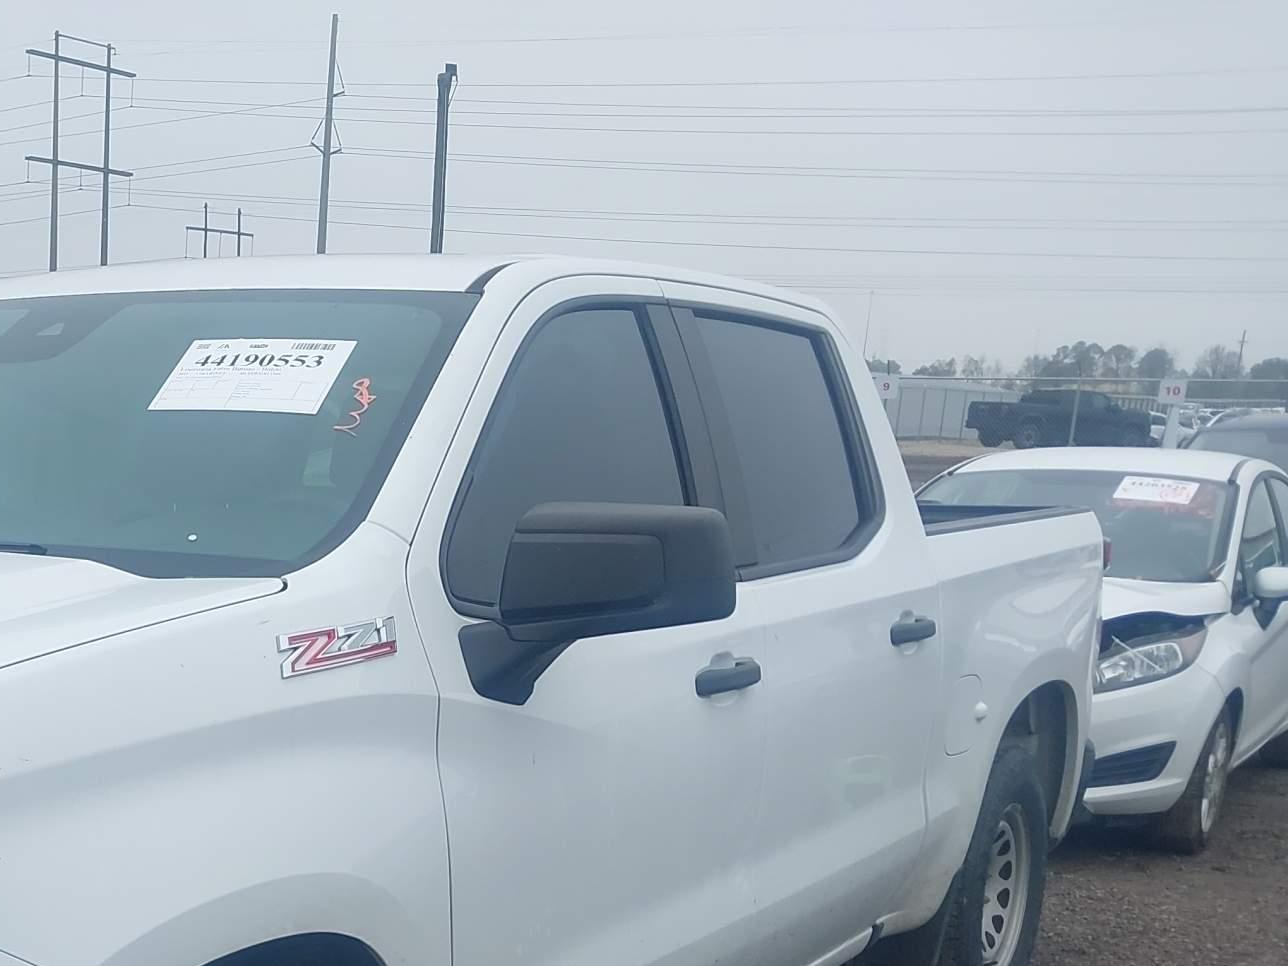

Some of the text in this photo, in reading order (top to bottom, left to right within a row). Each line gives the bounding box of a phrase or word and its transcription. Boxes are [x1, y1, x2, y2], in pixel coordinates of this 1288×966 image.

[194, 353, 325, 369] 44190553
[882, 382, 890, 391] 9
[1166, 386, 1181, 396] 10
[276, 616, 398, 679] Z71
